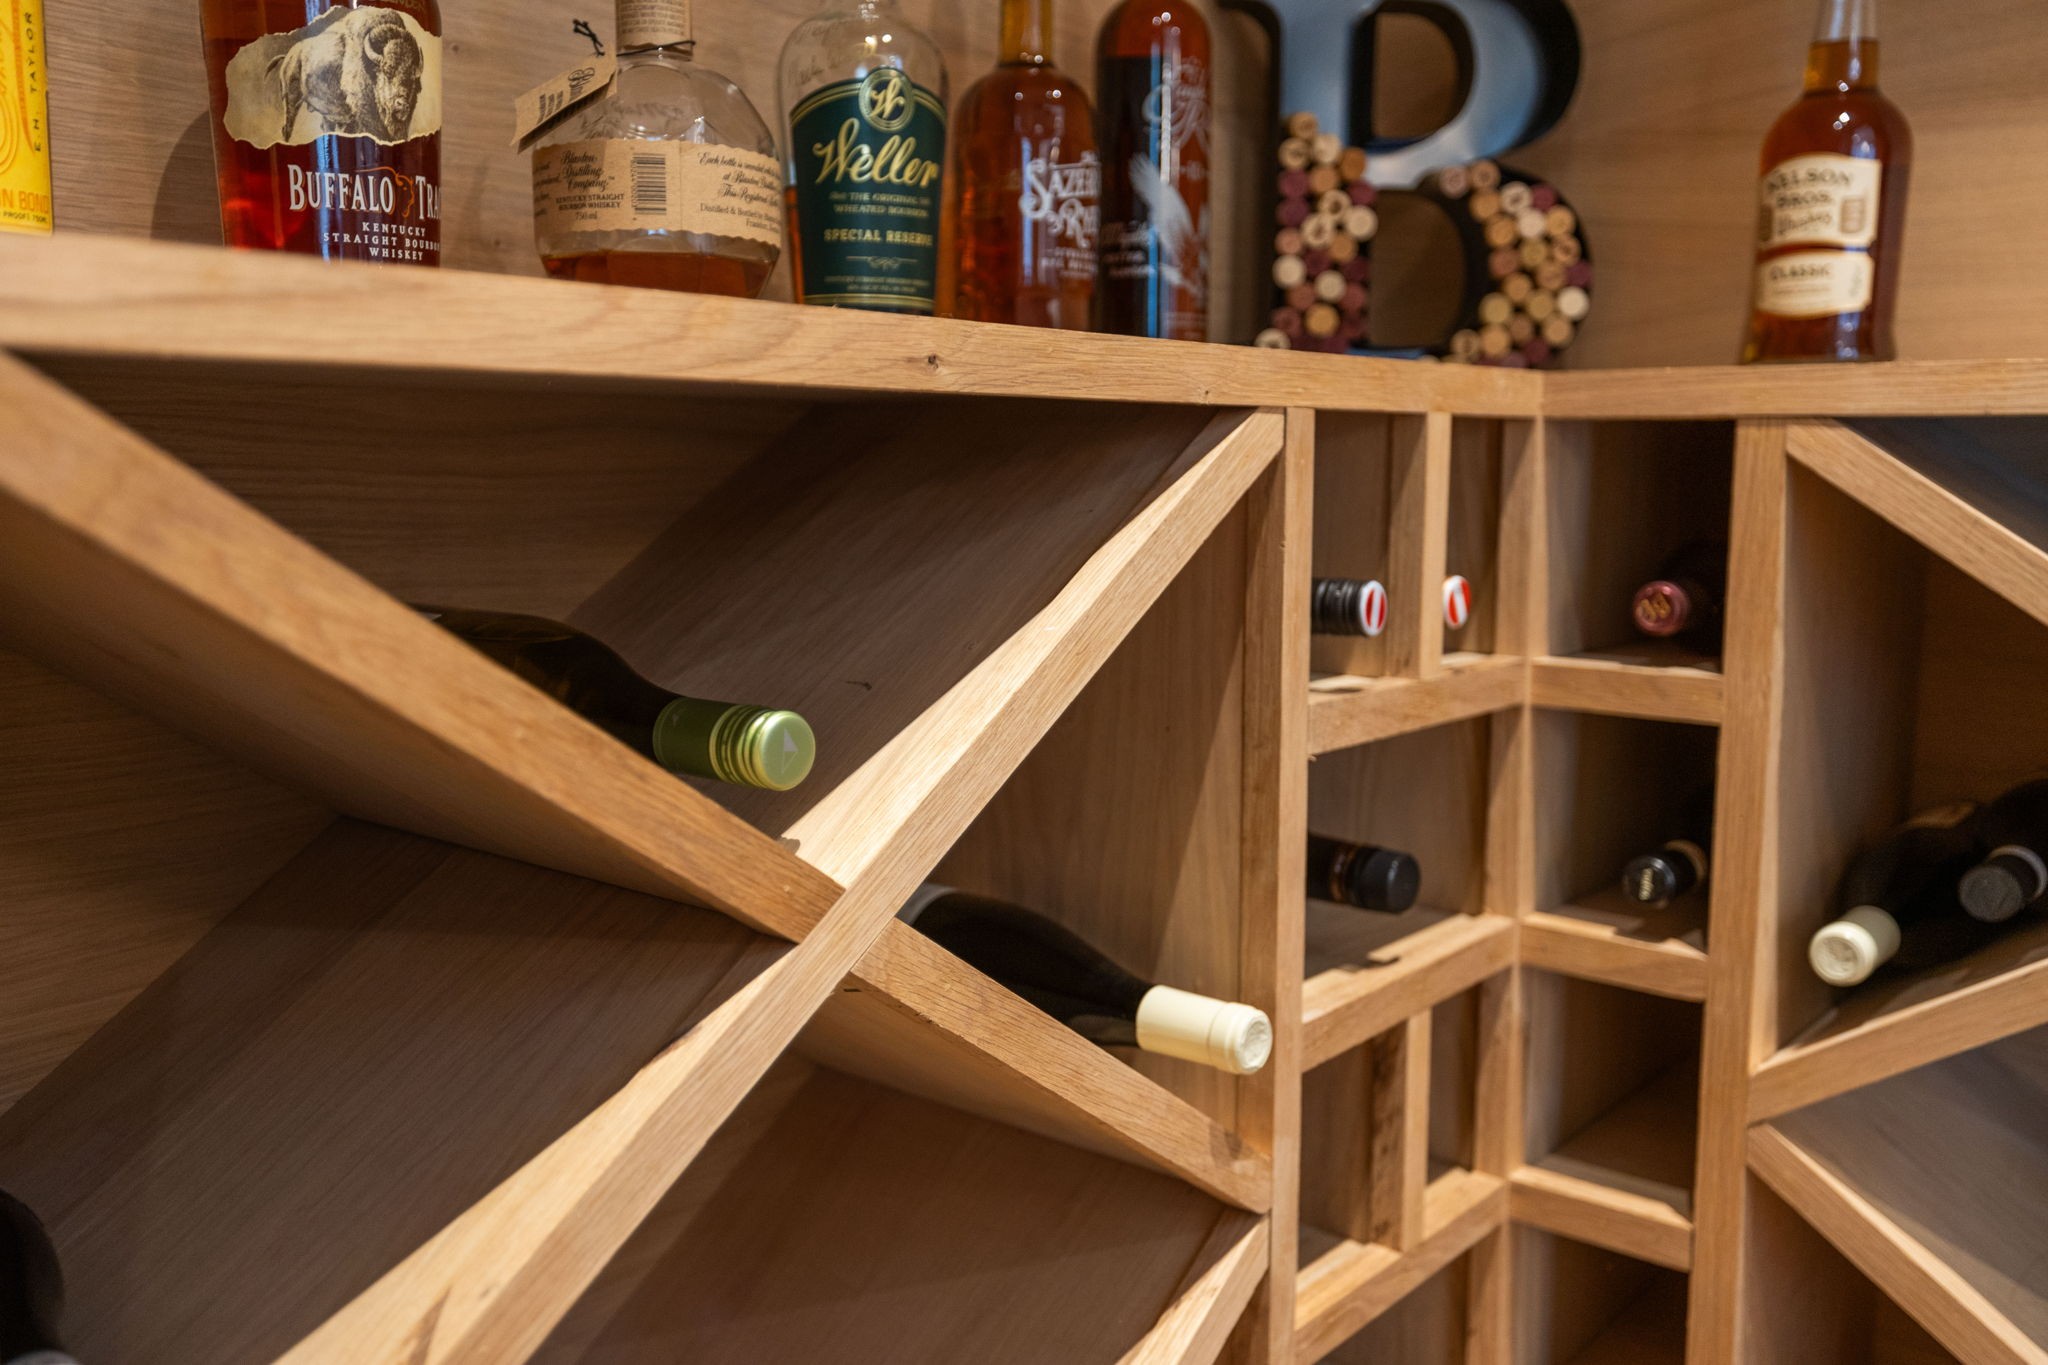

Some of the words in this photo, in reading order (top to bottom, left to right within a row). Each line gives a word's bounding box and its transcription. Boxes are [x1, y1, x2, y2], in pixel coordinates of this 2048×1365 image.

[24, 12, 37, 93] TAYLOR
[812, 117, 939, 188] Weller
[287, 164, 395, 214] BUFFALO
[415, 175, 440, 220] TRA
[362, 222, 426, 237] KENTUCKY
[824, 228, 881, 242] SPECIAL
[323, 232, 398, 246] STRAIGHT
[369, 247, 424, 261] WHISKEY
